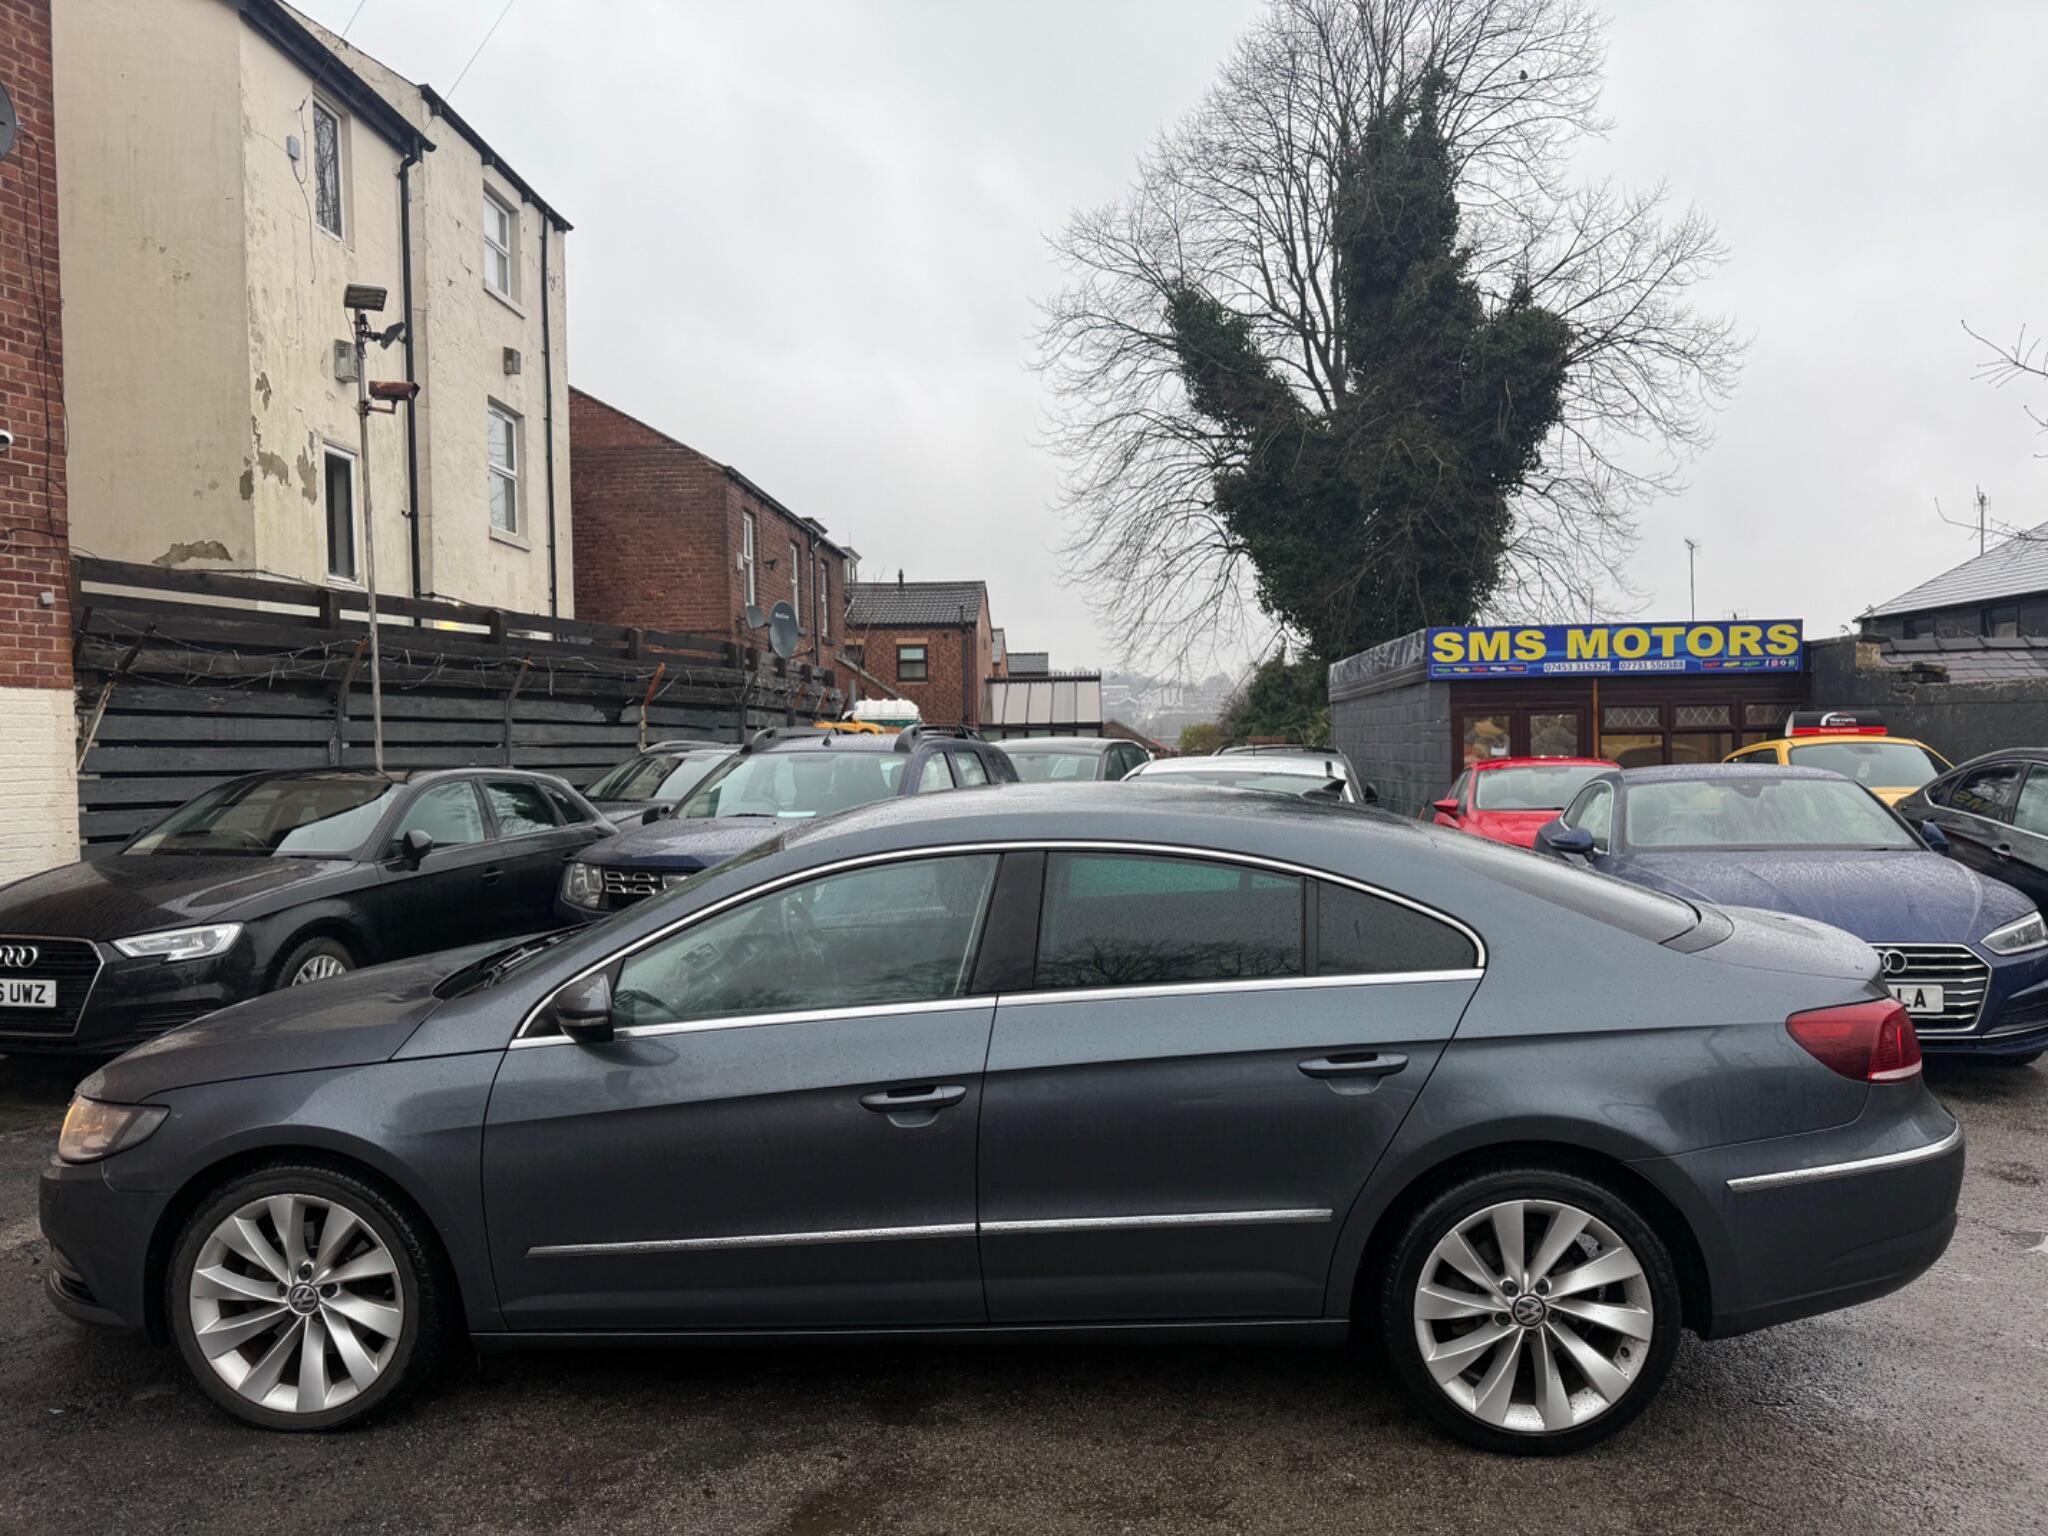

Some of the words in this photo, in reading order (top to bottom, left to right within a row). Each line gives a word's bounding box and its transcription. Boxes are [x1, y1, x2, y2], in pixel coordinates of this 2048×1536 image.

[1432, 631, 1547, 662] SMS
[1566, 625, 1799, 659] MOTORS
[9, 983, 46, 1004] UWZ
